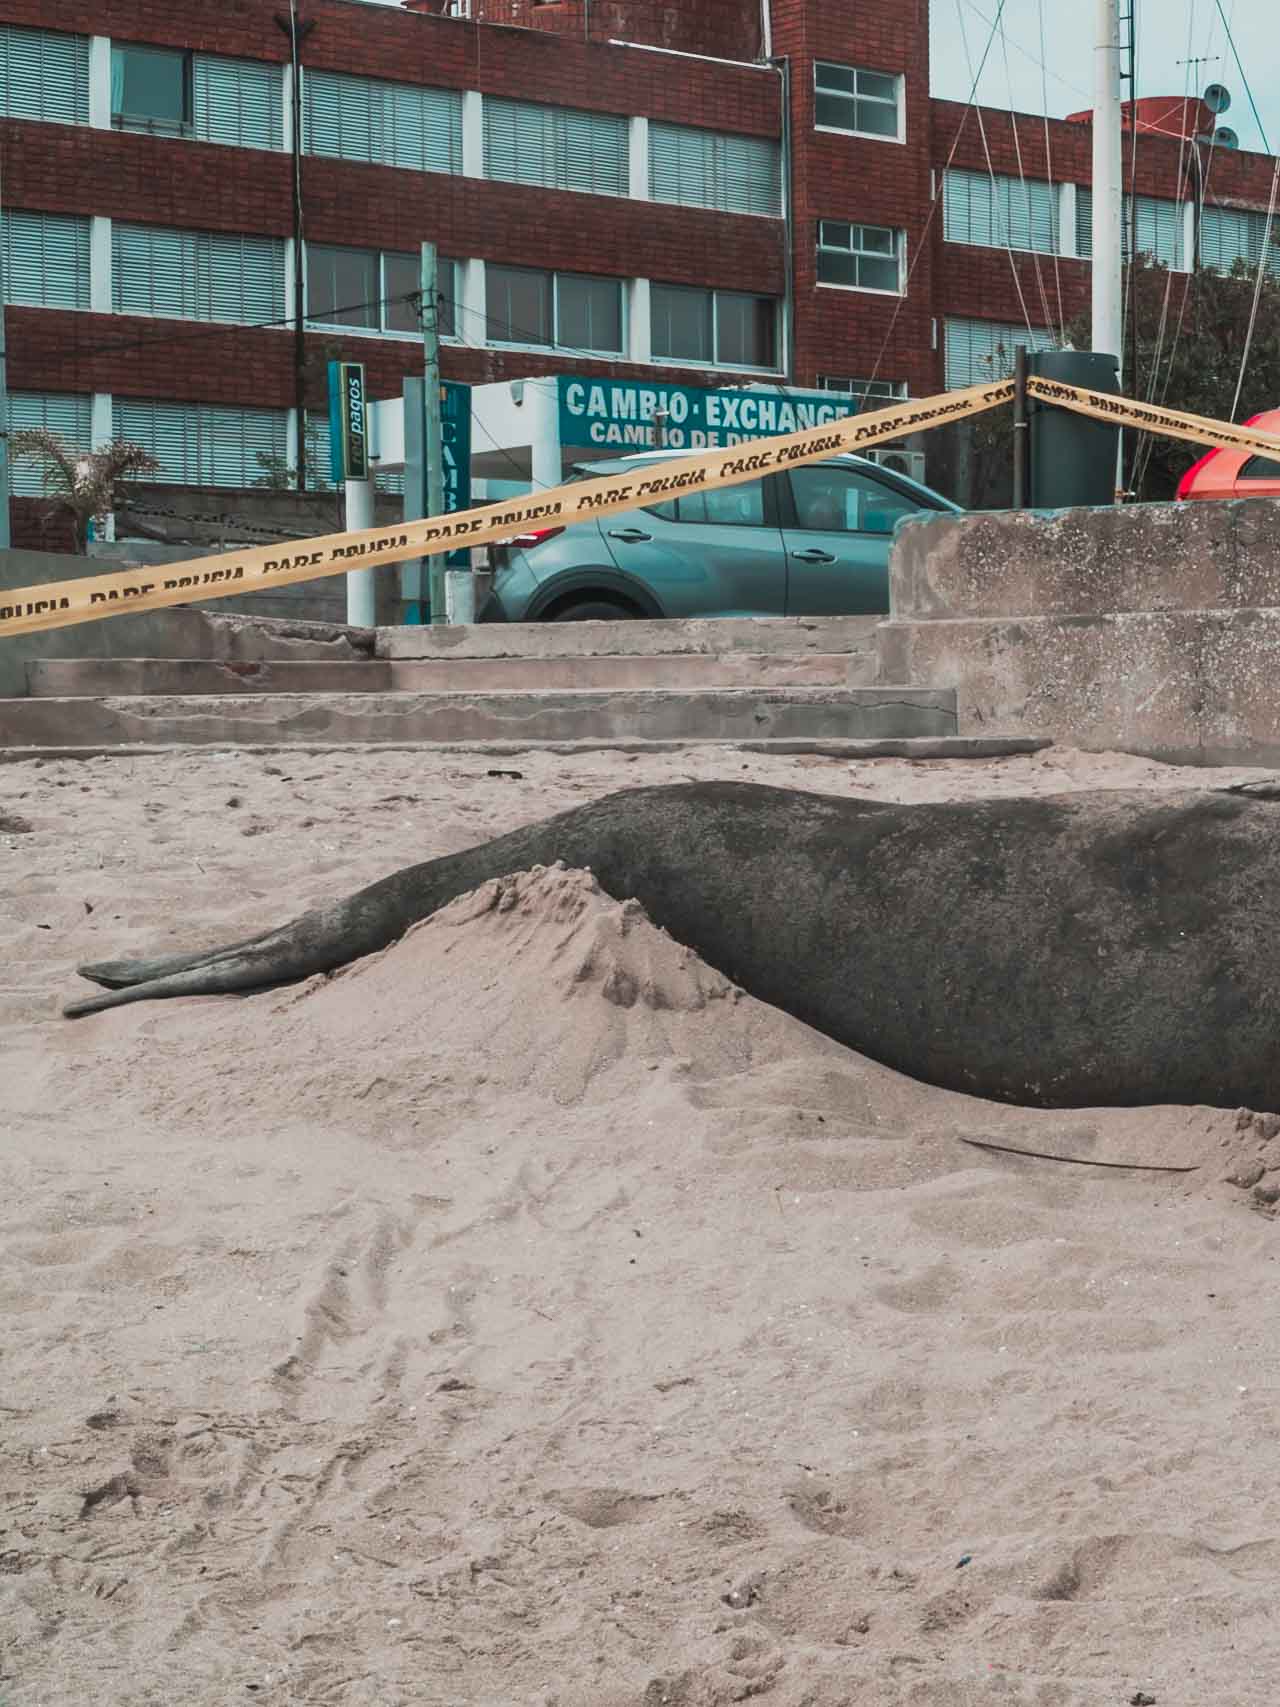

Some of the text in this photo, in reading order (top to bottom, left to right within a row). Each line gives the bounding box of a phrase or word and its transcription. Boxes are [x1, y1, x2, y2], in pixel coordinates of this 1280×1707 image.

[566, 384, 688, 423] CAMBIO
[590, 422, 685, 449] CAMBIO
[691, 430, 719, 449] DE
